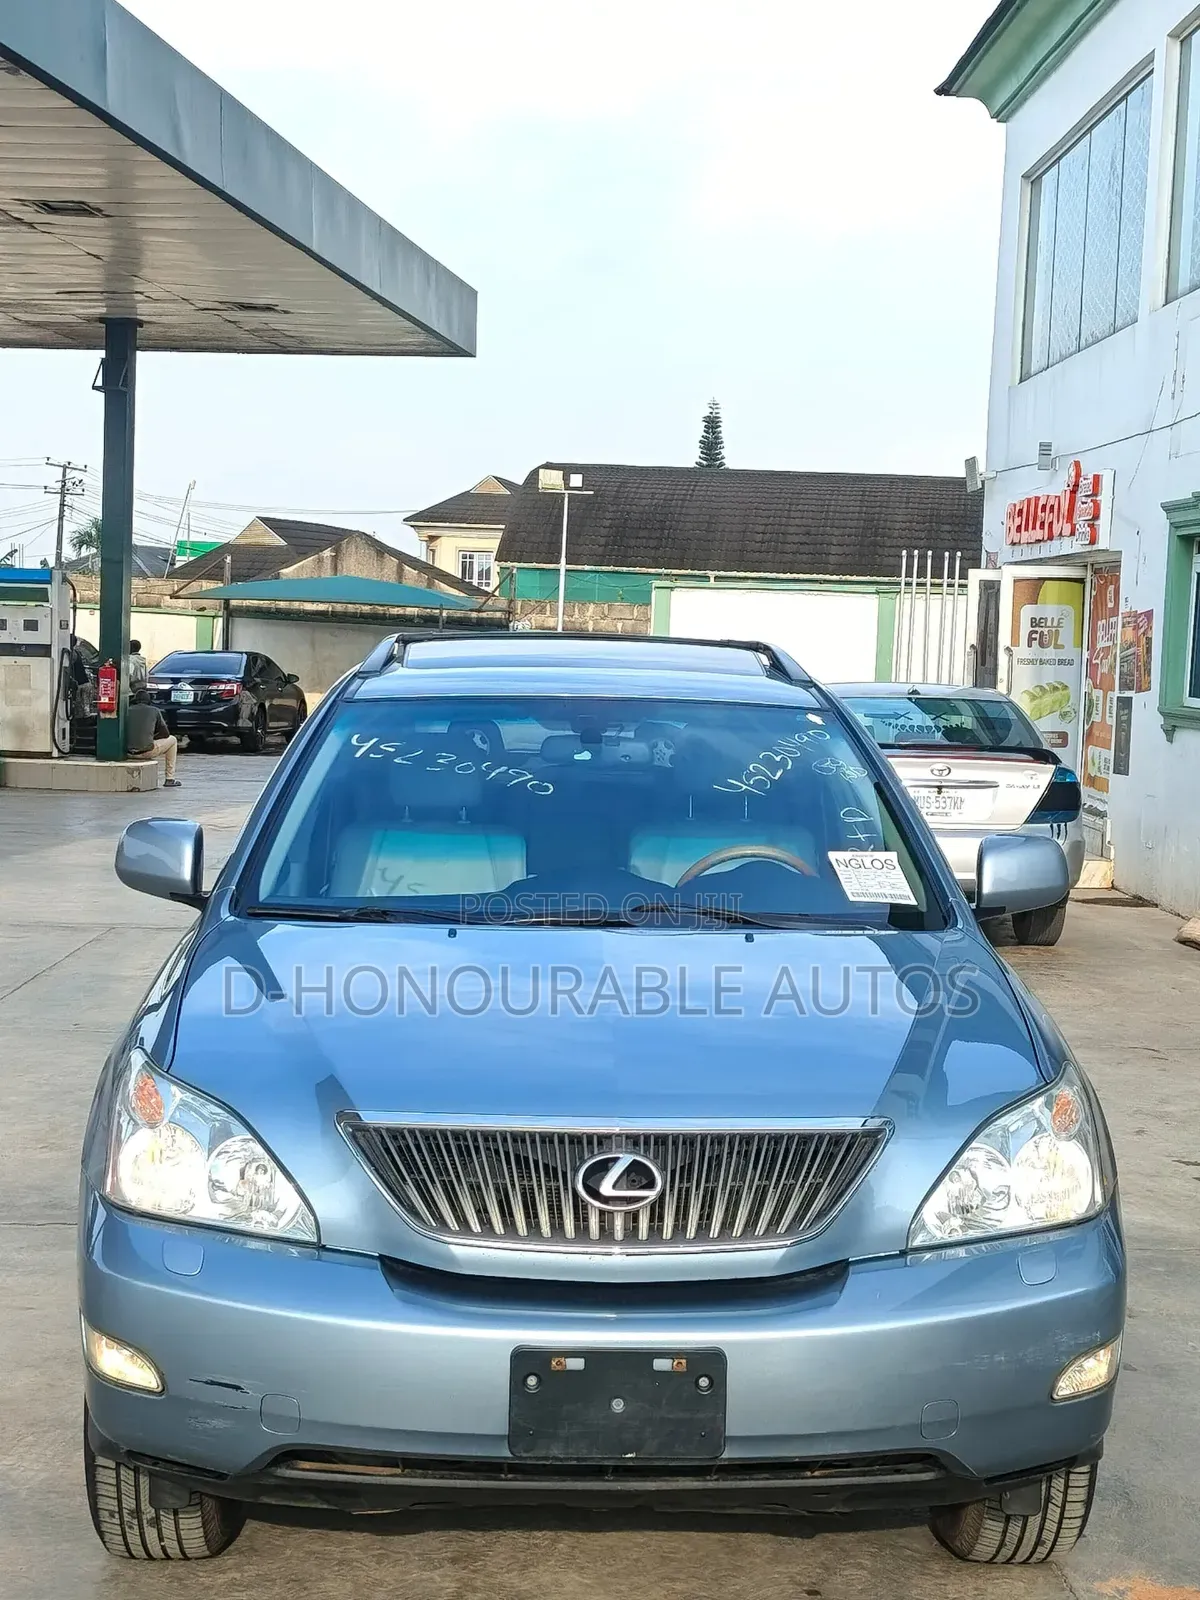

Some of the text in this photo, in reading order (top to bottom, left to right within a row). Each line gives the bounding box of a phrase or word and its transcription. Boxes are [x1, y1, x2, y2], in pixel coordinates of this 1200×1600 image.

[1005, 489, 1075, 545] BELLEFUL
[1030, 616, 1065, 628] BELLE
[1027, 629, 1065, 650] FUL
[1017, 657, 1075, 667] FRESHLY BAKED BREAD
[834, 858, 897, 871] NGLOS
